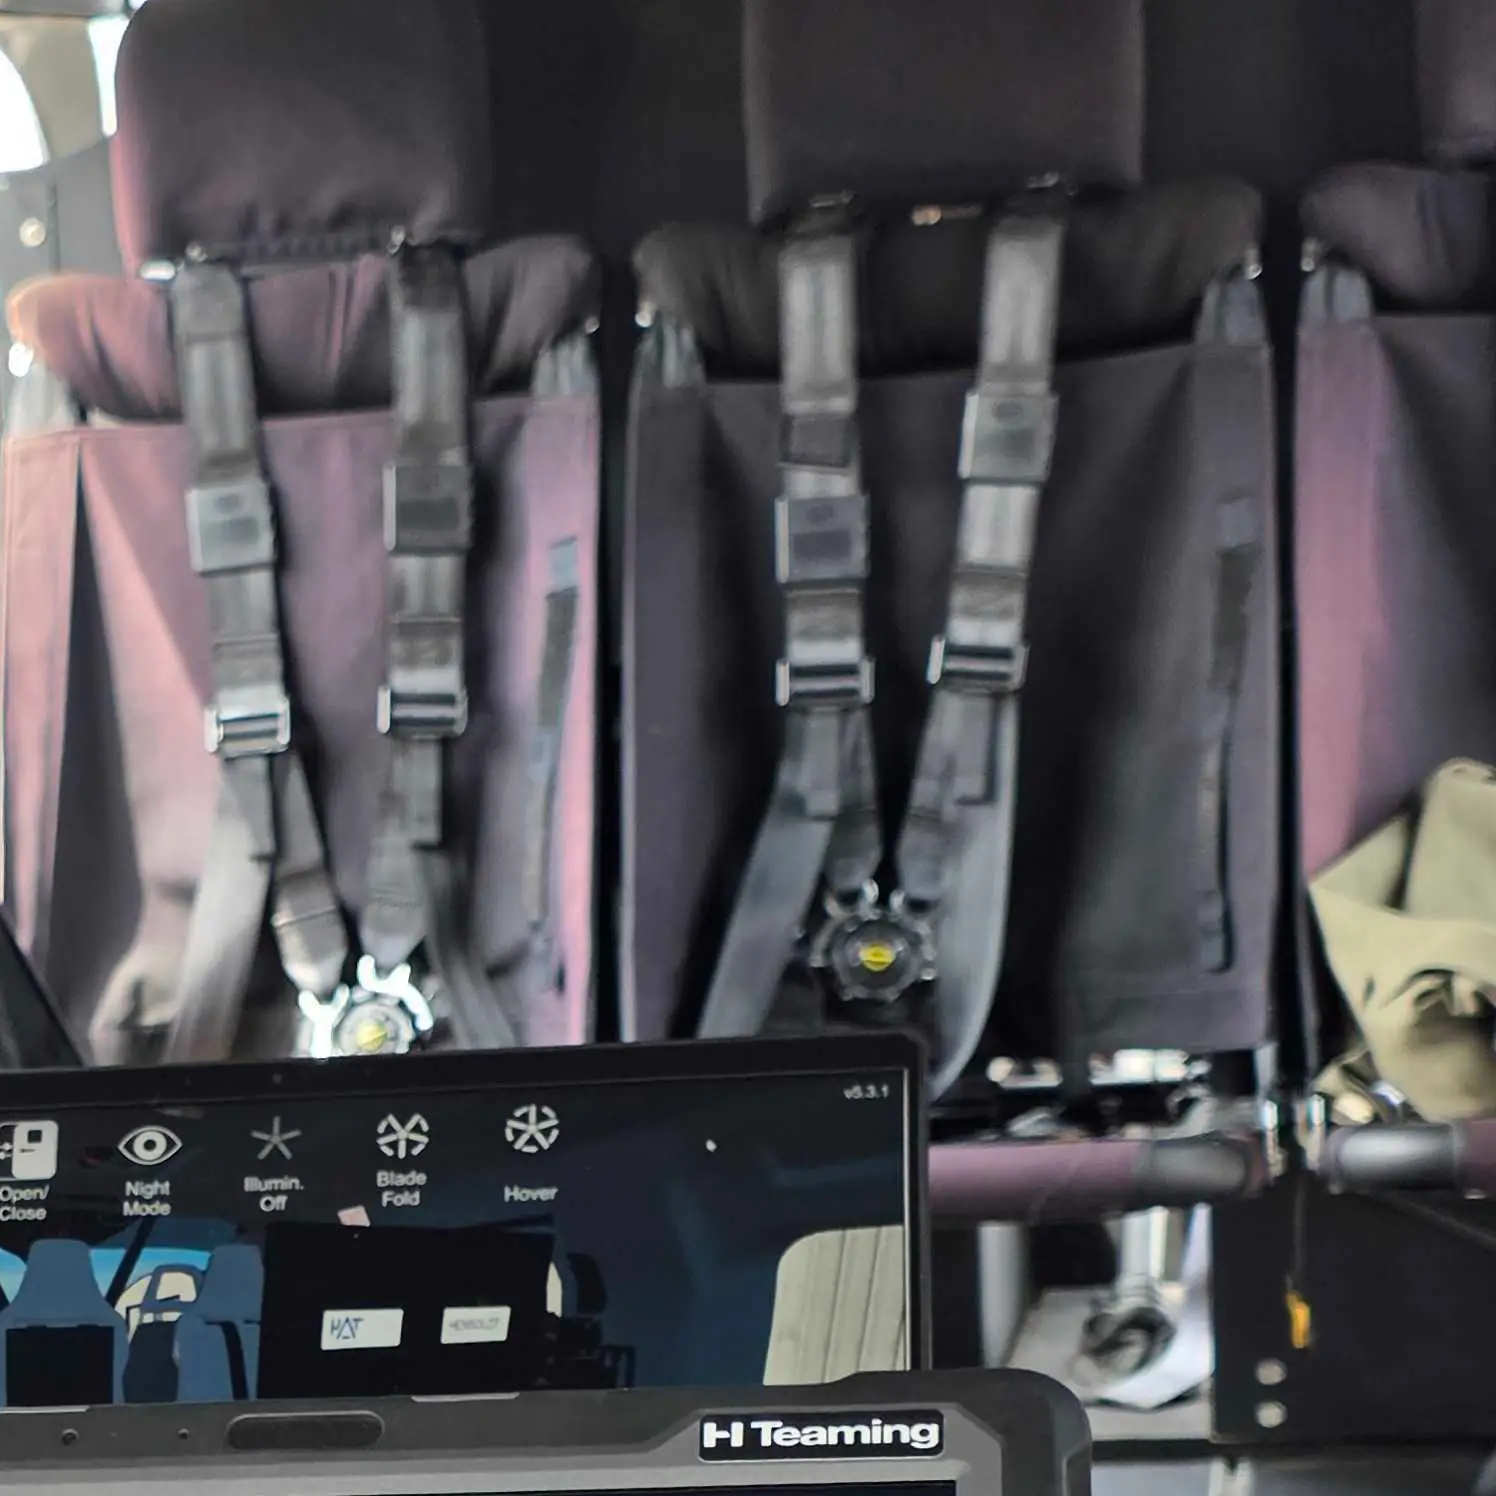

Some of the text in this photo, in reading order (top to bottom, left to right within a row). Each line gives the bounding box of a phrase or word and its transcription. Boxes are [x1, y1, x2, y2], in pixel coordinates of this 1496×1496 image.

[243, 1176, 304, 1192] Illumin.
[376, 1170, 427, 1187] Blade
[125, 1180, 170, 1199] Night
[504, 1186, 558, 1202] Hover
[259, 1195, 287, 1212] Off
[381, 1191, 420, 1207] Fold
[122, 1201, 171, 1216] Mode
[750, 1418, 940, 1448] Teaming
